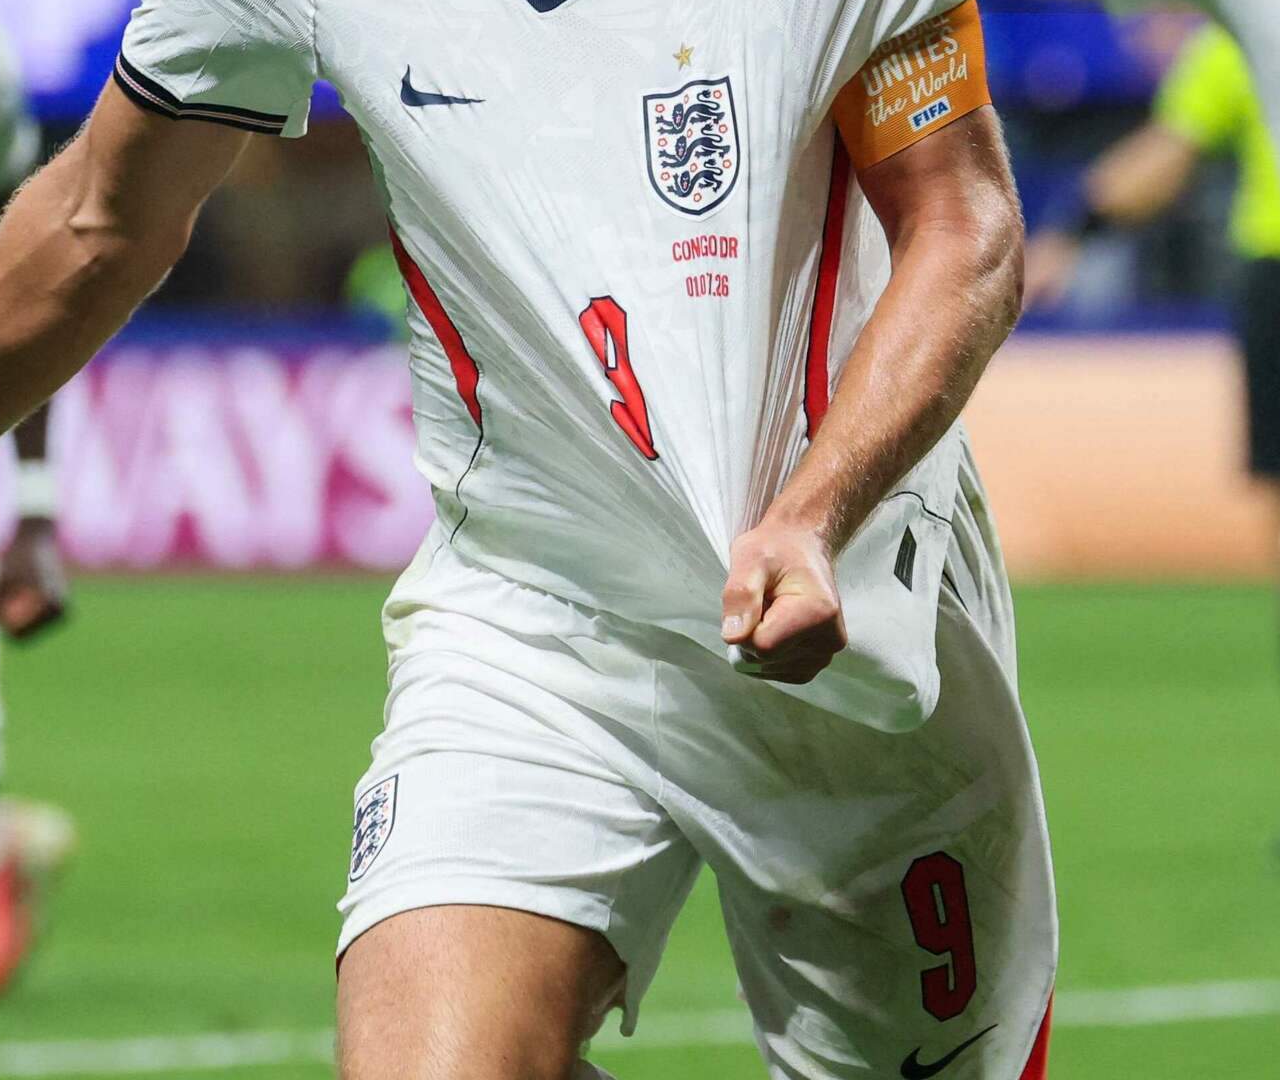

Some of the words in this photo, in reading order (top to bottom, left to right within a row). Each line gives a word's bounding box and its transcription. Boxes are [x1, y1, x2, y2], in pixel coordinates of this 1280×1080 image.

[862, 26, 959, 97] UNITES
[865, 95, 908, 128] the
[907, 52, 968, 104] World
[912, 101, 949, 128] FIFA
[672, 234, 718, 262] CONGO
[719, 235, 738, 259] DR
[578, 294, 660, 461] 9
[900, 850, 977, 1022] 9
